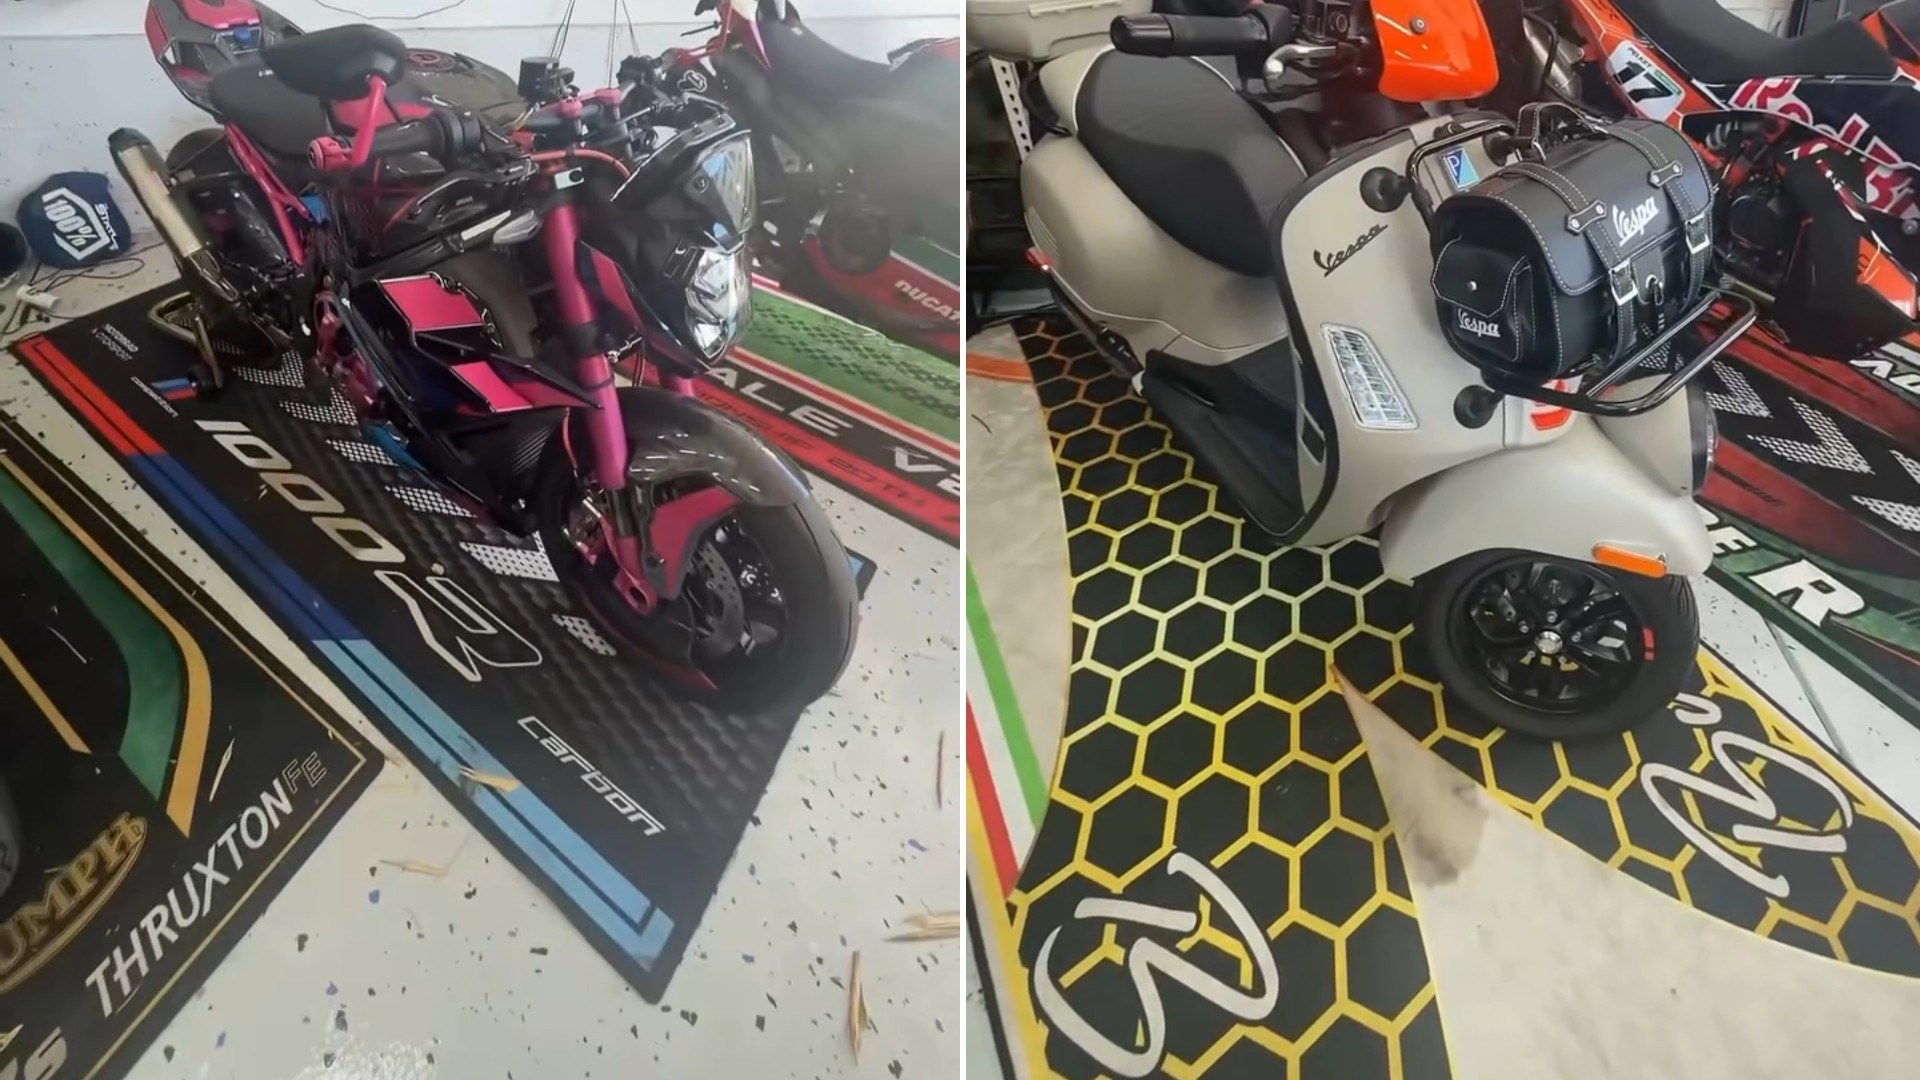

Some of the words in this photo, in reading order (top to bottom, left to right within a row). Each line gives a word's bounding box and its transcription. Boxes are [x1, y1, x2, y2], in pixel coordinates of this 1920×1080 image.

[1613, 61, 1674, 103] 17
[43, 199, 98, 247] 100%
[1612, 196, 1660, 247] Vespa
[1313, 223, 1389, 278] Vespa
[894, 280, 960, 325] DUCAT
[1457, 309, 1502, 338] Vespa
[194, 419, 407, 563] 1000
